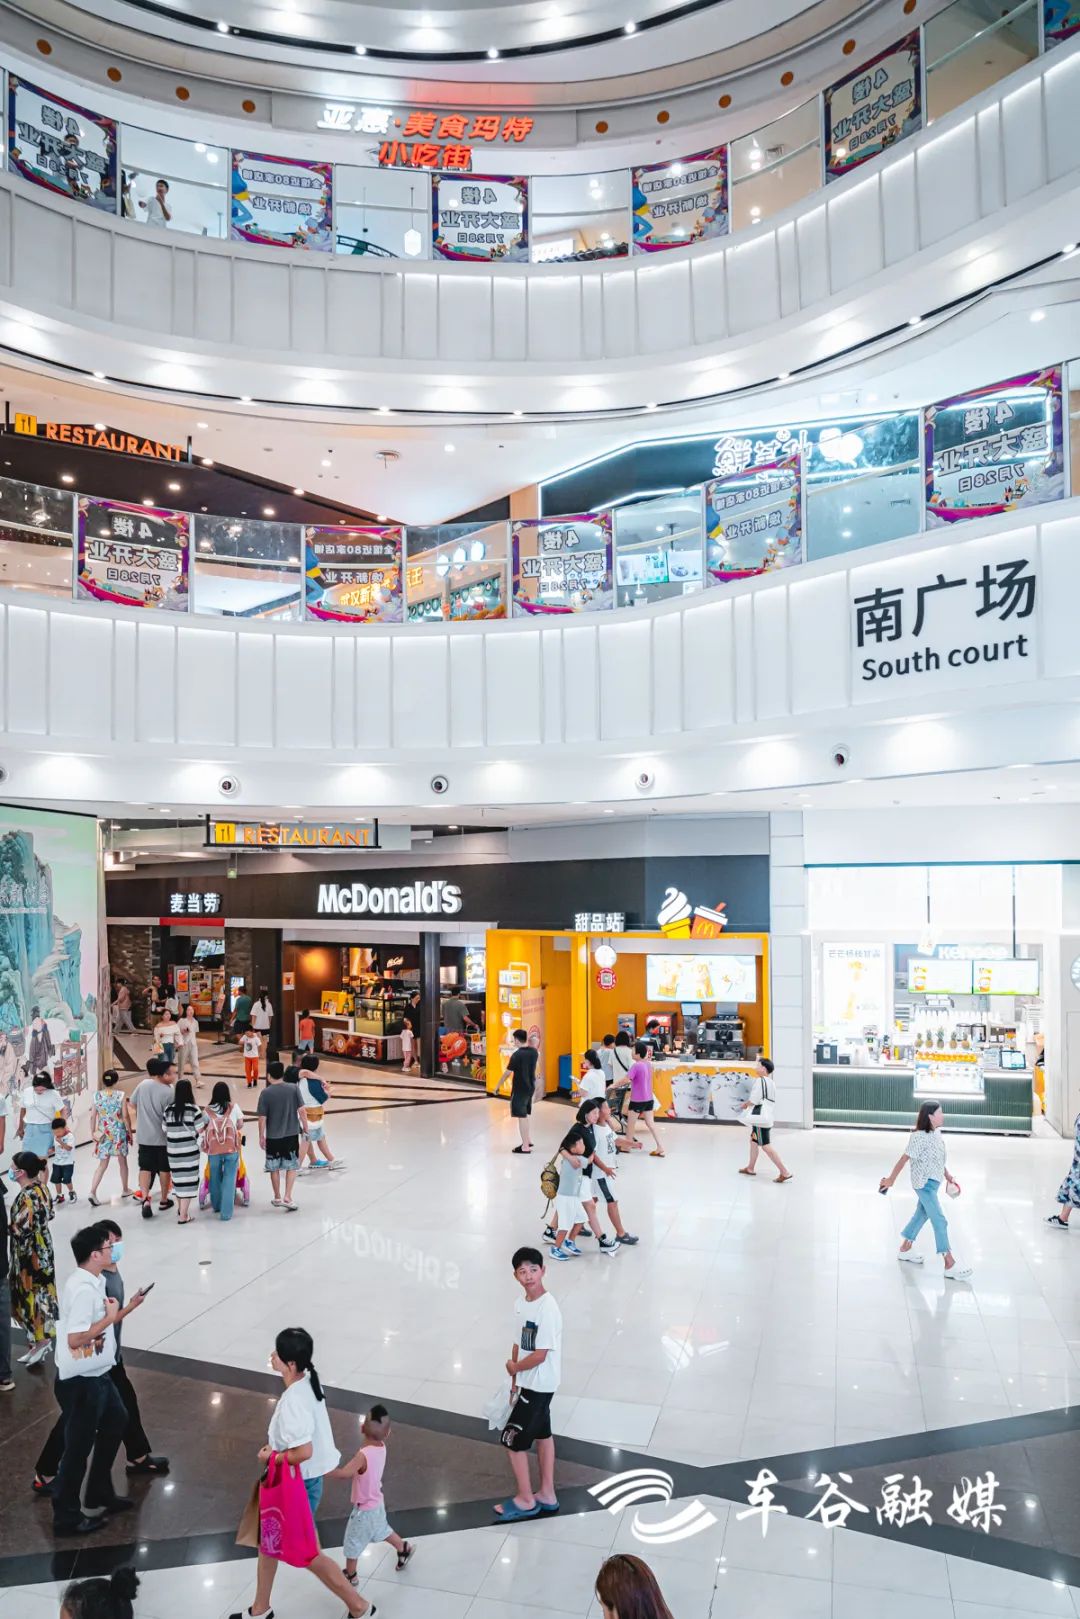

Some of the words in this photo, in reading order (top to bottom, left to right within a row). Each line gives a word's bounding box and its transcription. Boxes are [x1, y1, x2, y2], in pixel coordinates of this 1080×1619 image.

[379, 140, 473, 167] 小吃街
[46, 422, 184, 461] RESTAURANT
[853, 559, 1036, 647] 南广场
[861, 647, 940, 681] South
[947, 634, 1028, 667] court
[243, 826, 370, 846] RESTAURANT
[169, 893, 220, 913] 麦当劳
[316, 880, 463, 914] McDonald's
[574, 911, 625, 932] 甜品站
